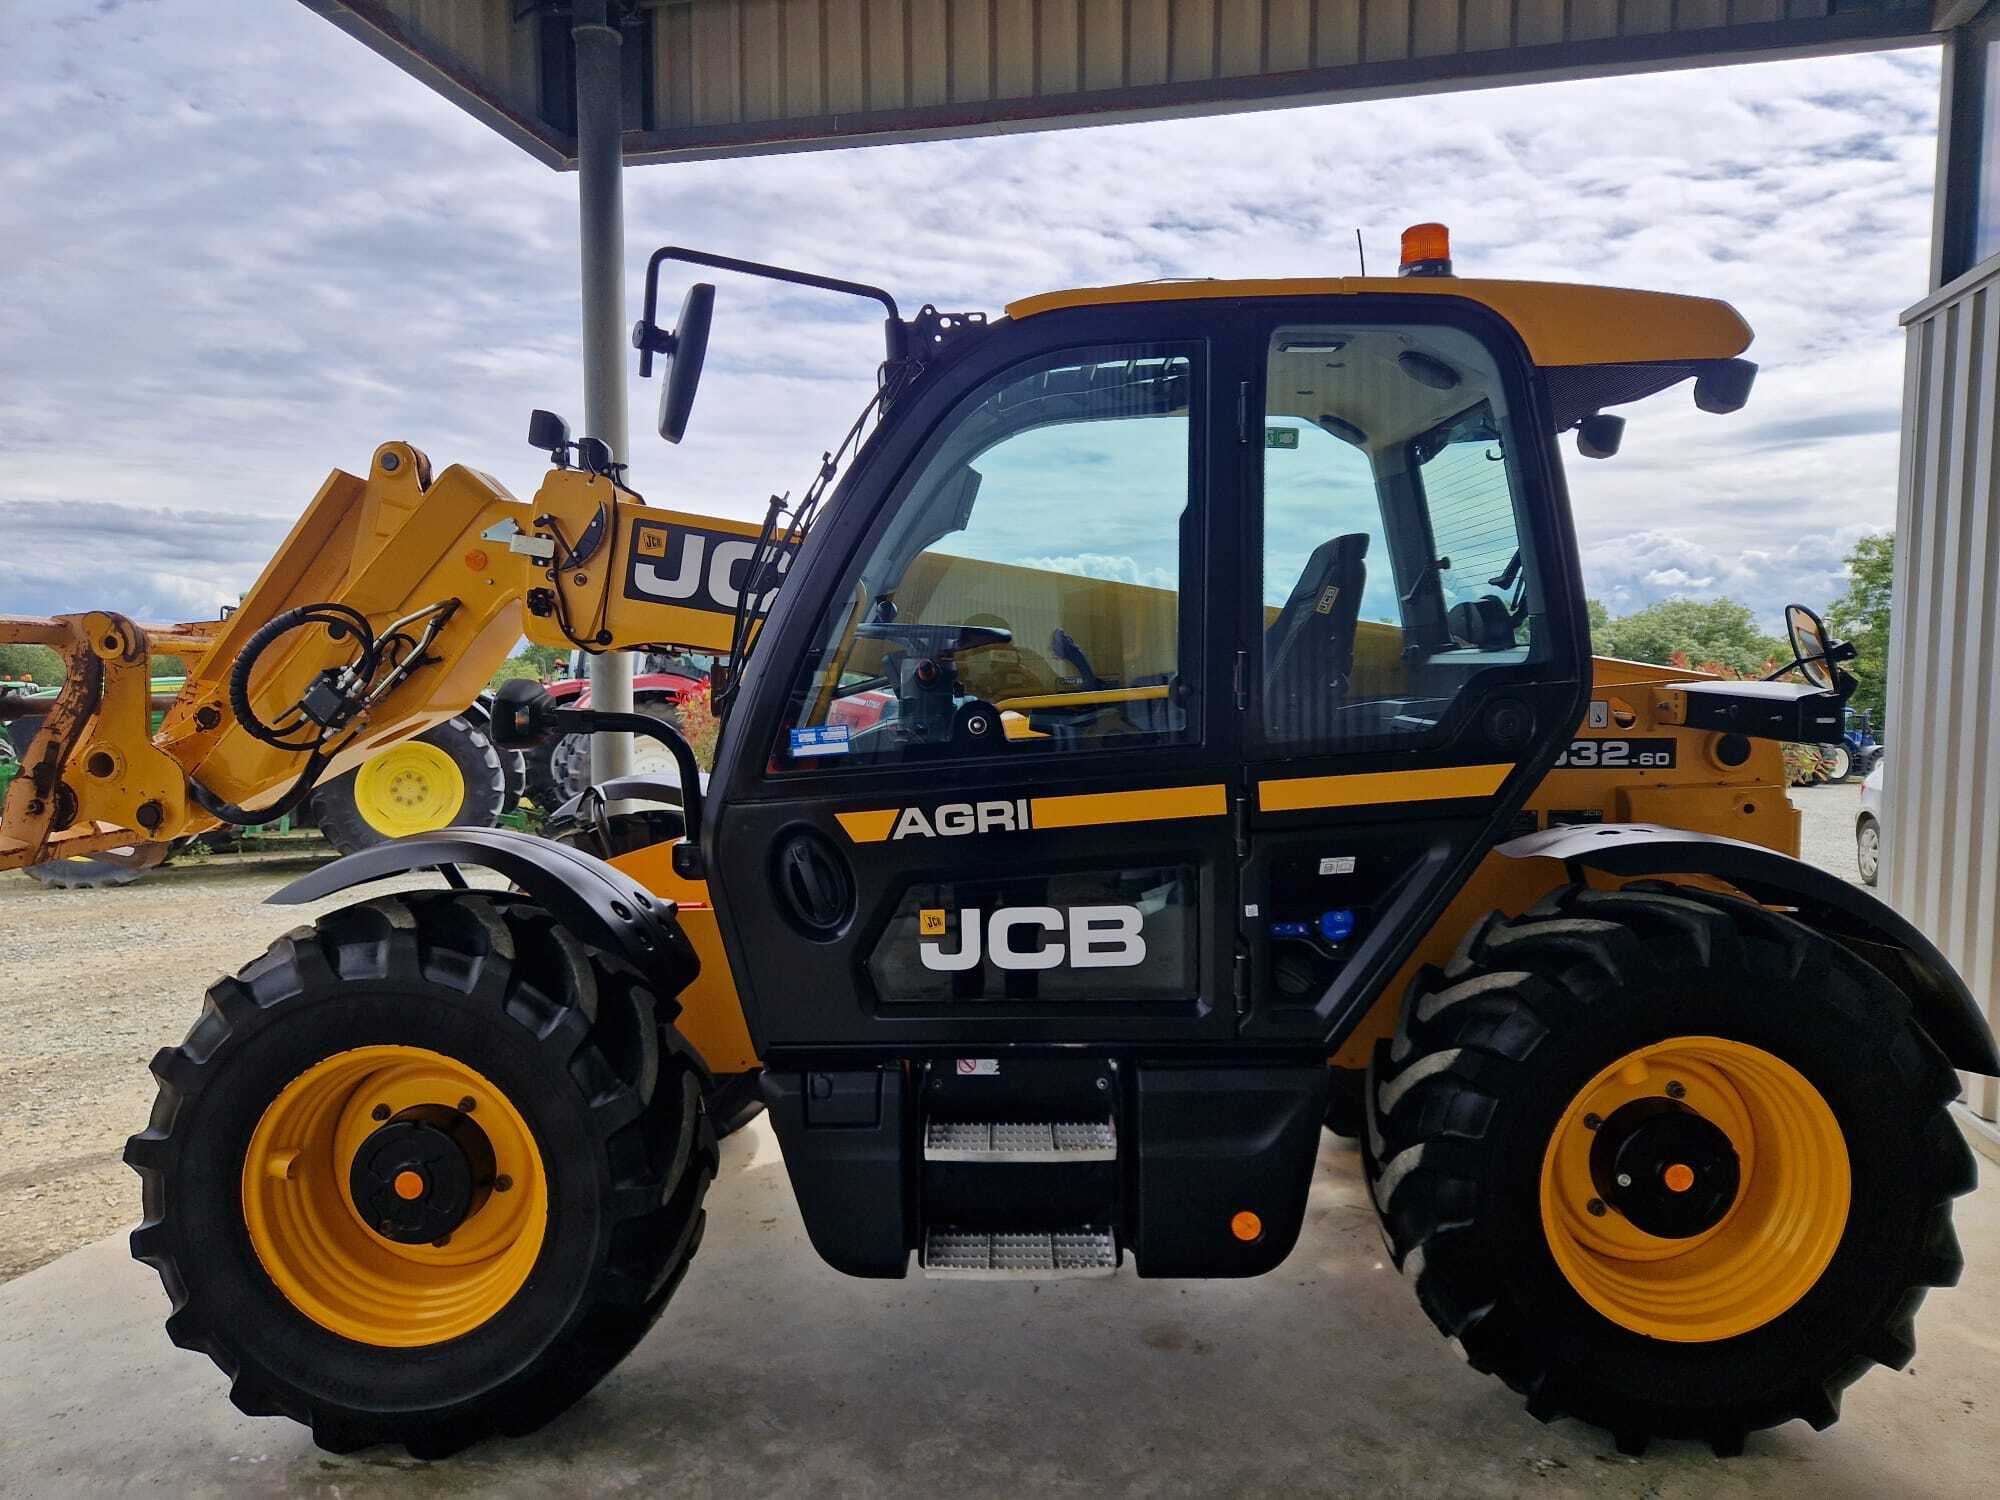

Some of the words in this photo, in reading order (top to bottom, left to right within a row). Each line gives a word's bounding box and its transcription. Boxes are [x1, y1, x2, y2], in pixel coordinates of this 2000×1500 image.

[1554, 741, 1670, 766] 32-60
[892, 799, 1029, 840] AGRI
[920, 905, 1147, 971] JCB
